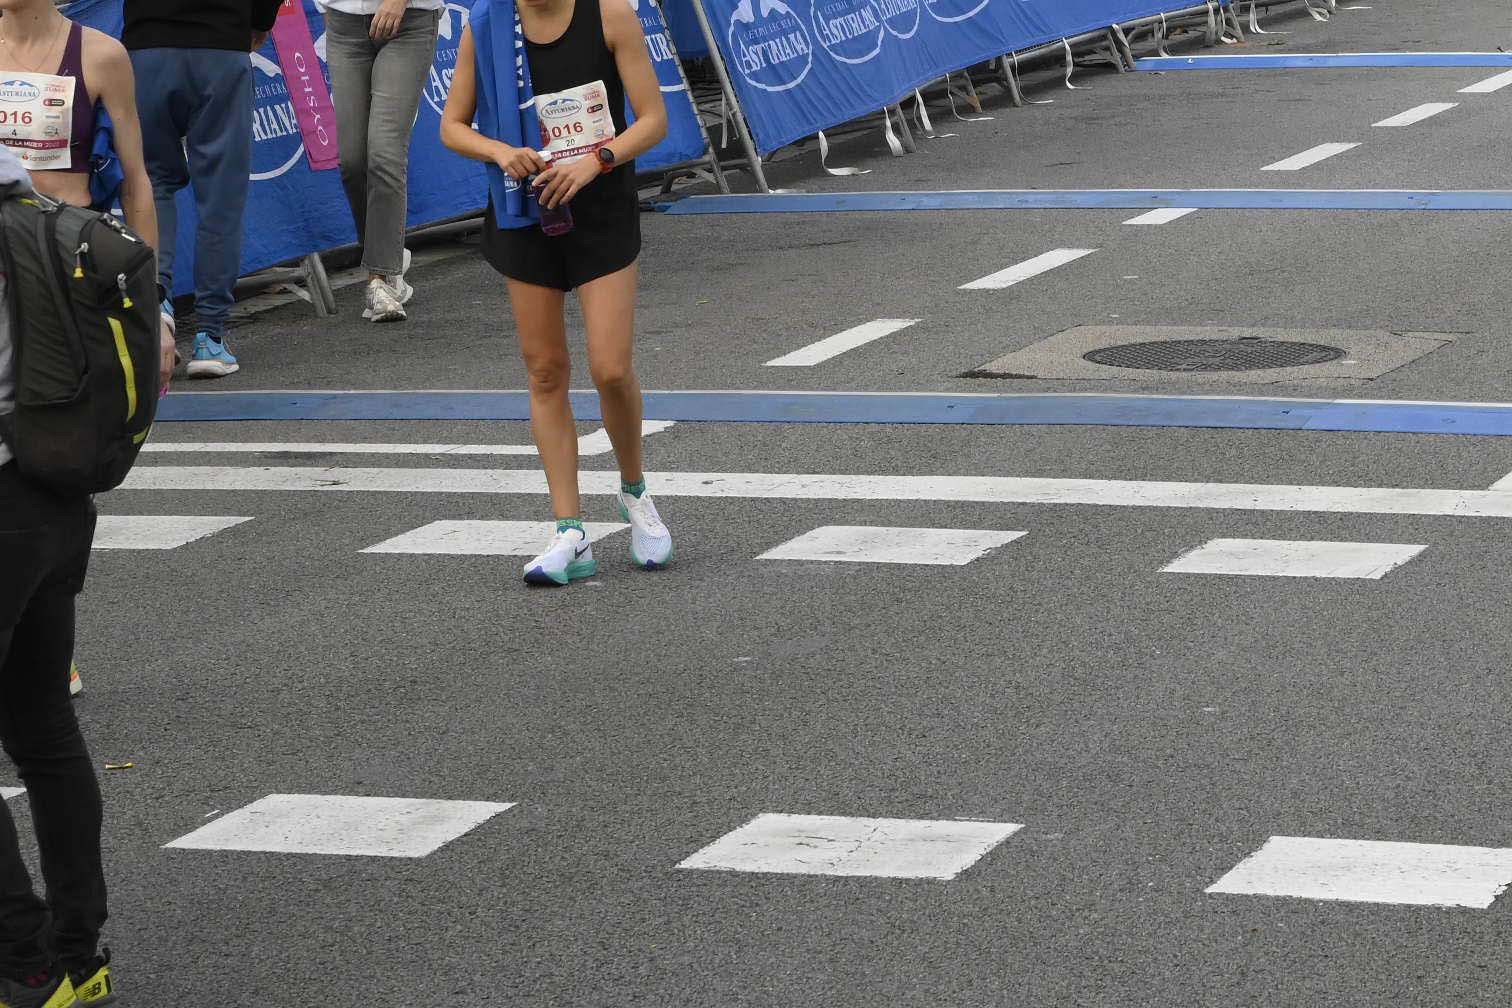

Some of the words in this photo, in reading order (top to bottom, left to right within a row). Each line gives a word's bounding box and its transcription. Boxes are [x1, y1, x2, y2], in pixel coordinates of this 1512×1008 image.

[818, 5, 880, 46] ASTURIAN
[294, 51, 329, 147] OYSHO
[11, 129, 17, 137] 4
[252, 100, 301, 142] RIANA
[551, 121, 584, 138] 016
[565, 138, 576, 147] 20
